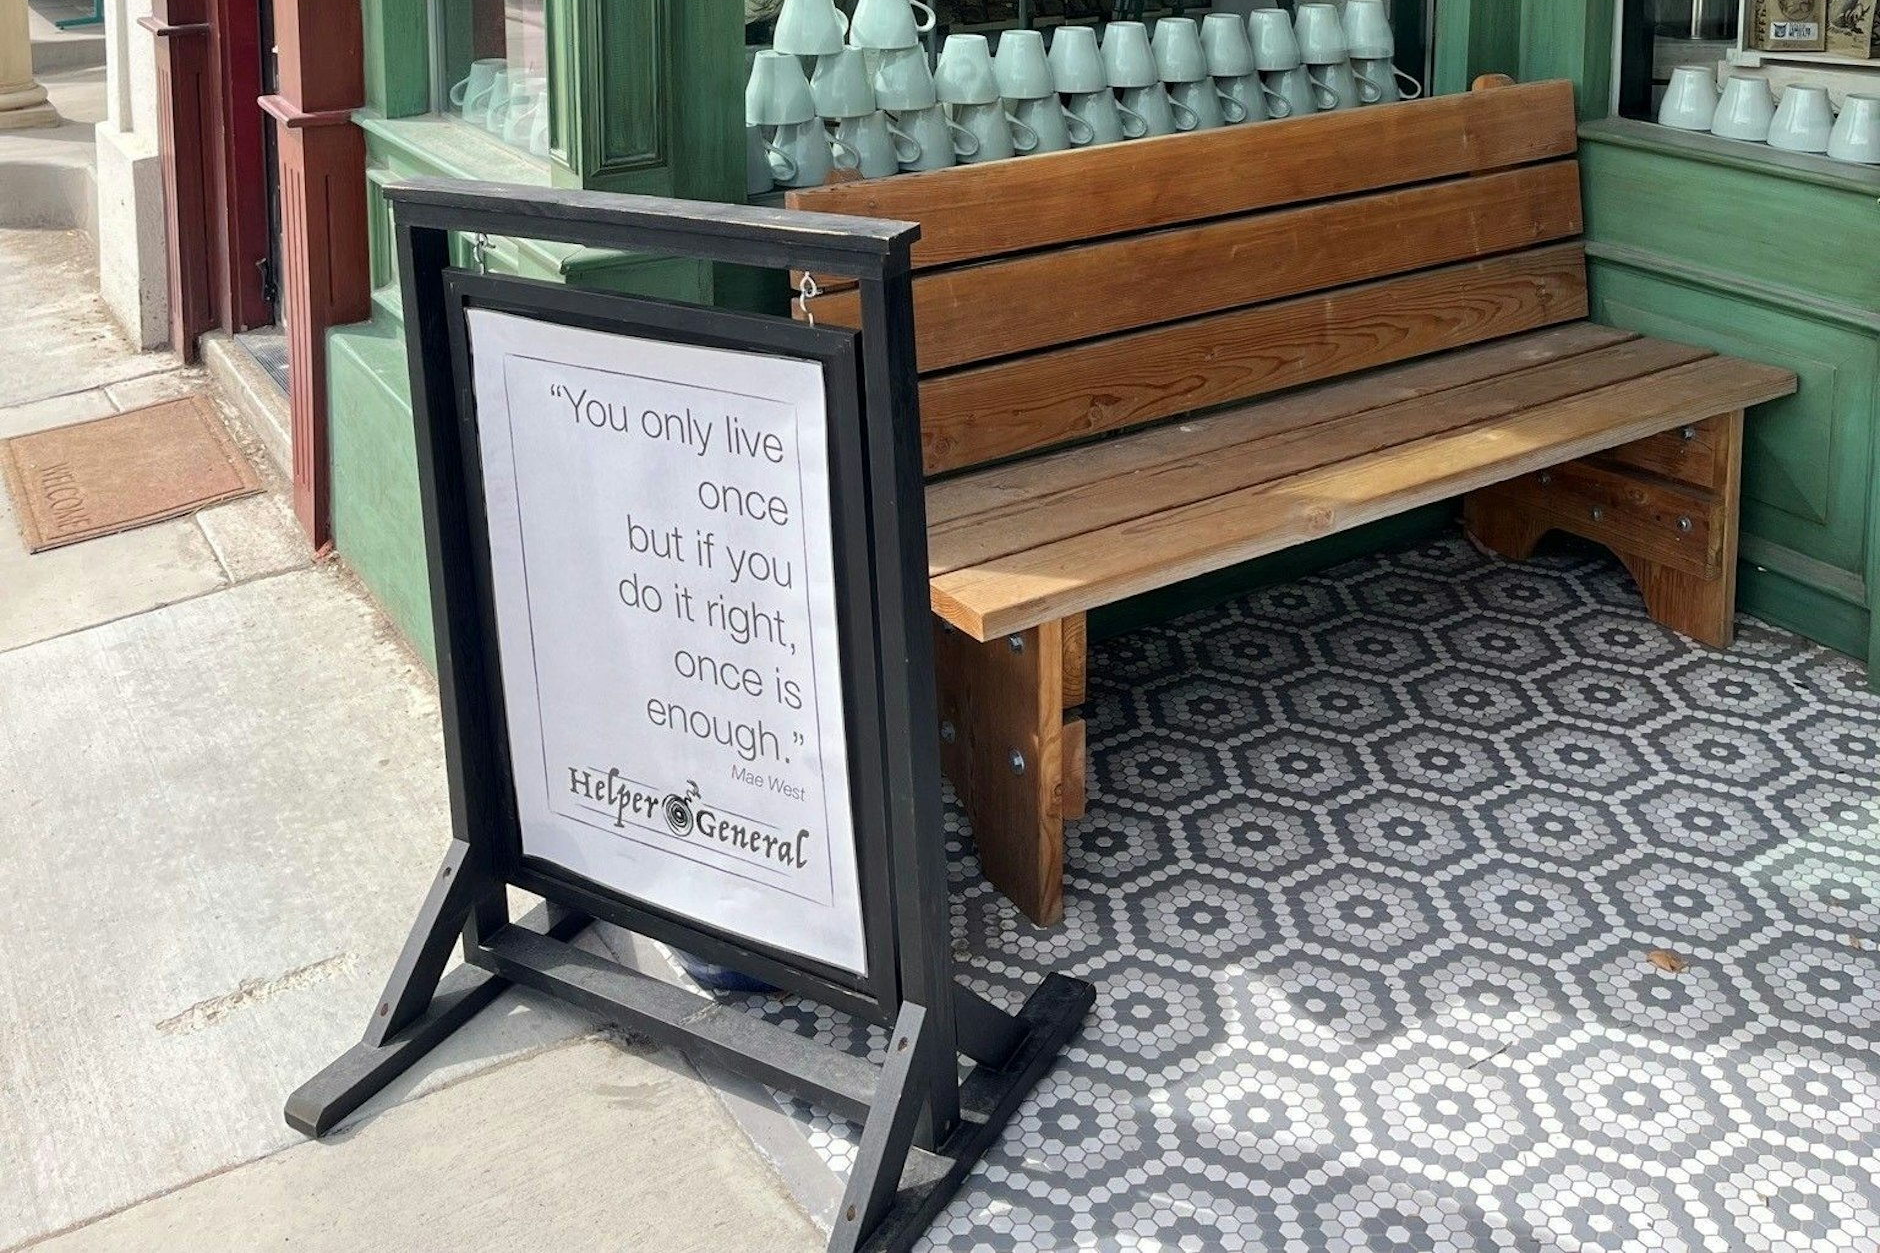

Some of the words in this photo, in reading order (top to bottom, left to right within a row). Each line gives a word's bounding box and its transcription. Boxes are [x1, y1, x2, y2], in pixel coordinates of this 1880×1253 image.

[641, 408, 712, 456] only
[726, 416, 783, 463] live
[41, 461, 91, 531] WELCOME
[699, 482, 788, 526] once
[627, 514, 684, 562] but
[697, 530, 714, 568] if
[726, 546, 792, 589] you
[619, 573, 662, 613] do
[674, 583, 695, 622] it
[707, 594, 795, 655] right,
[675, 650, 763, 696] once
[776, 667, 802, 709] is
[732, 765, 763, 787] Mae
[768, 776, 805, 801] West
[568, 767, 659, 827] Helper
[696, 810, 809, 869] General
